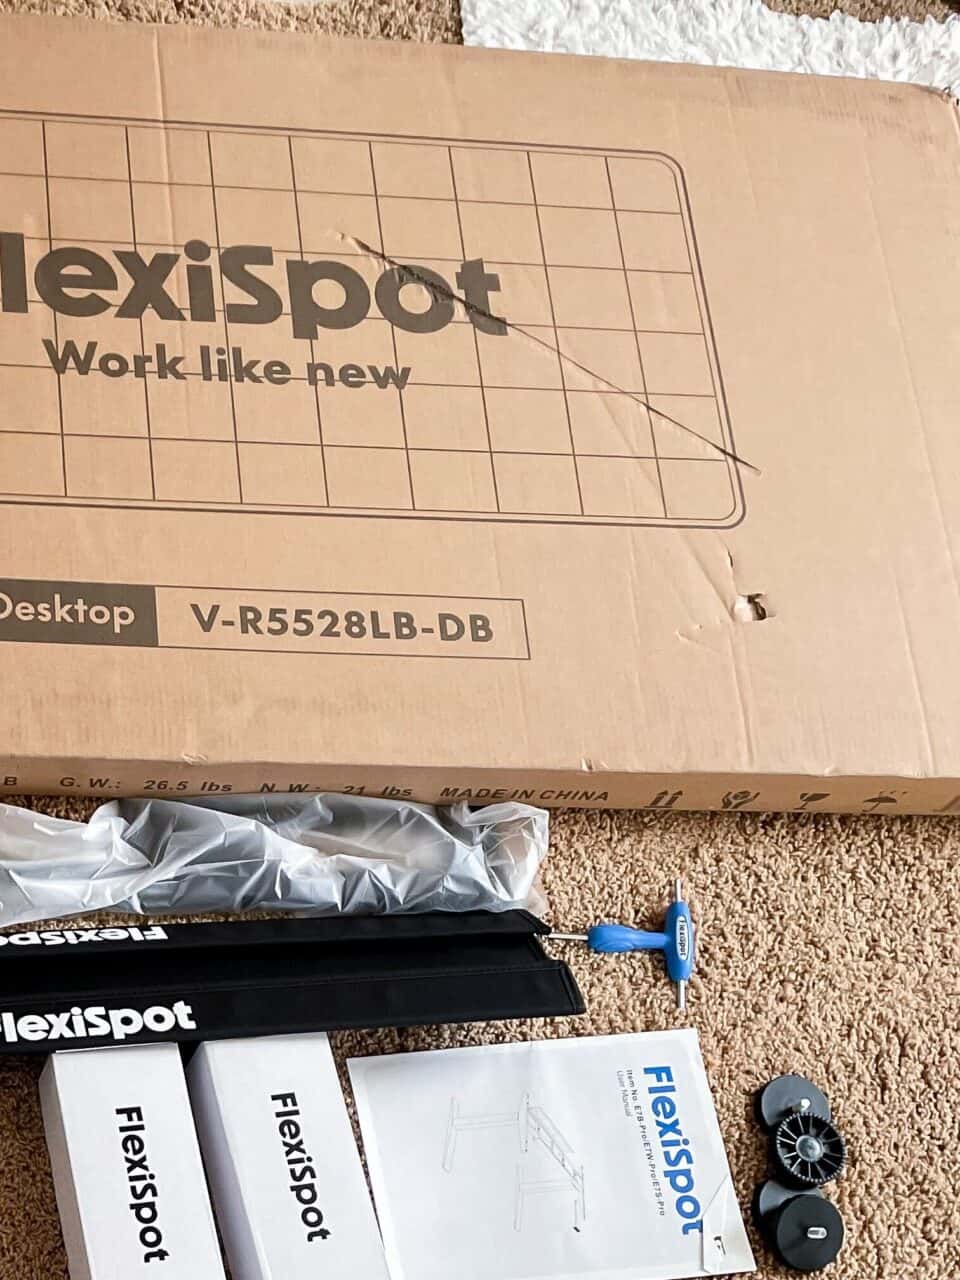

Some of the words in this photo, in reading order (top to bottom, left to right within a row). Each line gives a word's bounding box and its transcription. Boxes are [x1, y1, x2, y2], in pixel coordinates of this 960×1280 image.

[42, 338, 188, 381] Work
[200, 345, 292, 386] like
[307, 363, 412, 391] new
[190, 603, 495, 644] V-R5528LB-DB
[144, 779, 189, 791] 26.5
[200, 780, 233, 792] lbs
[343, 785, 366, 795] 21
[380, 786, 414, 797] lbs
[440, 787, 507, 800] MADE
[510, 789, 536, 800] IN
[540, 789, 609, 801] CHINA
[270, 1091, 332, 1243] FlexiSpot
[643, 1066, 704, 1236] FlexiSpot
[115, 1105, 170, 1264] FlexiSpot
